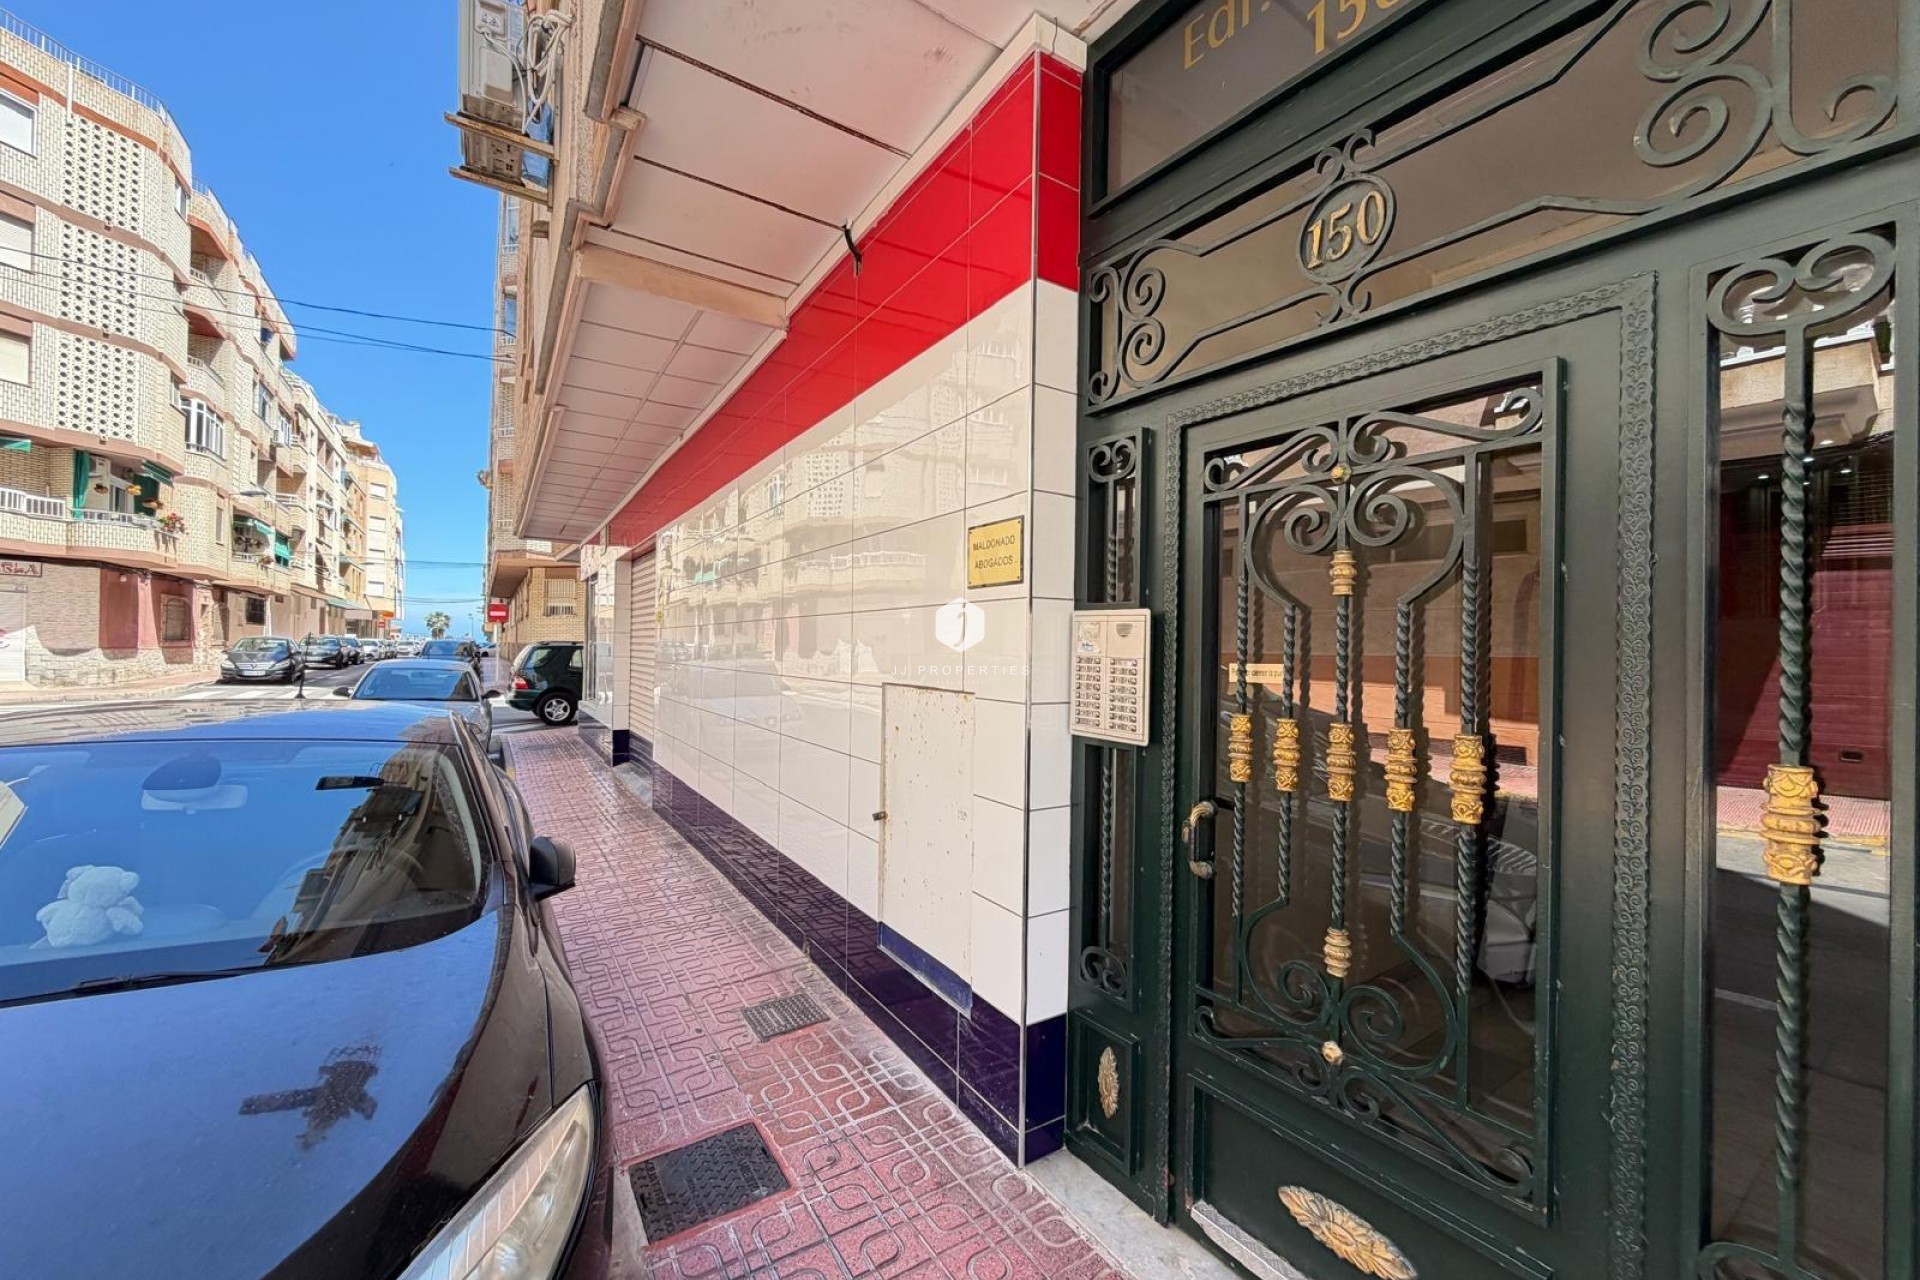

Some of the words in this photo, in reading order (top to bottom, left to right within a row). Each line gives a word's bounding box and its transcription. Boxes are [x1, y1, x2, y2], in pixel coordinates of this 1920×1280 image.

[1306, 0, 1400, 55] 15
[1307, 190, 1385, 269] 150
[973, 535, 1015, 551] MALDONADO
[975, 555, 1014, 569] ABOGADOS
